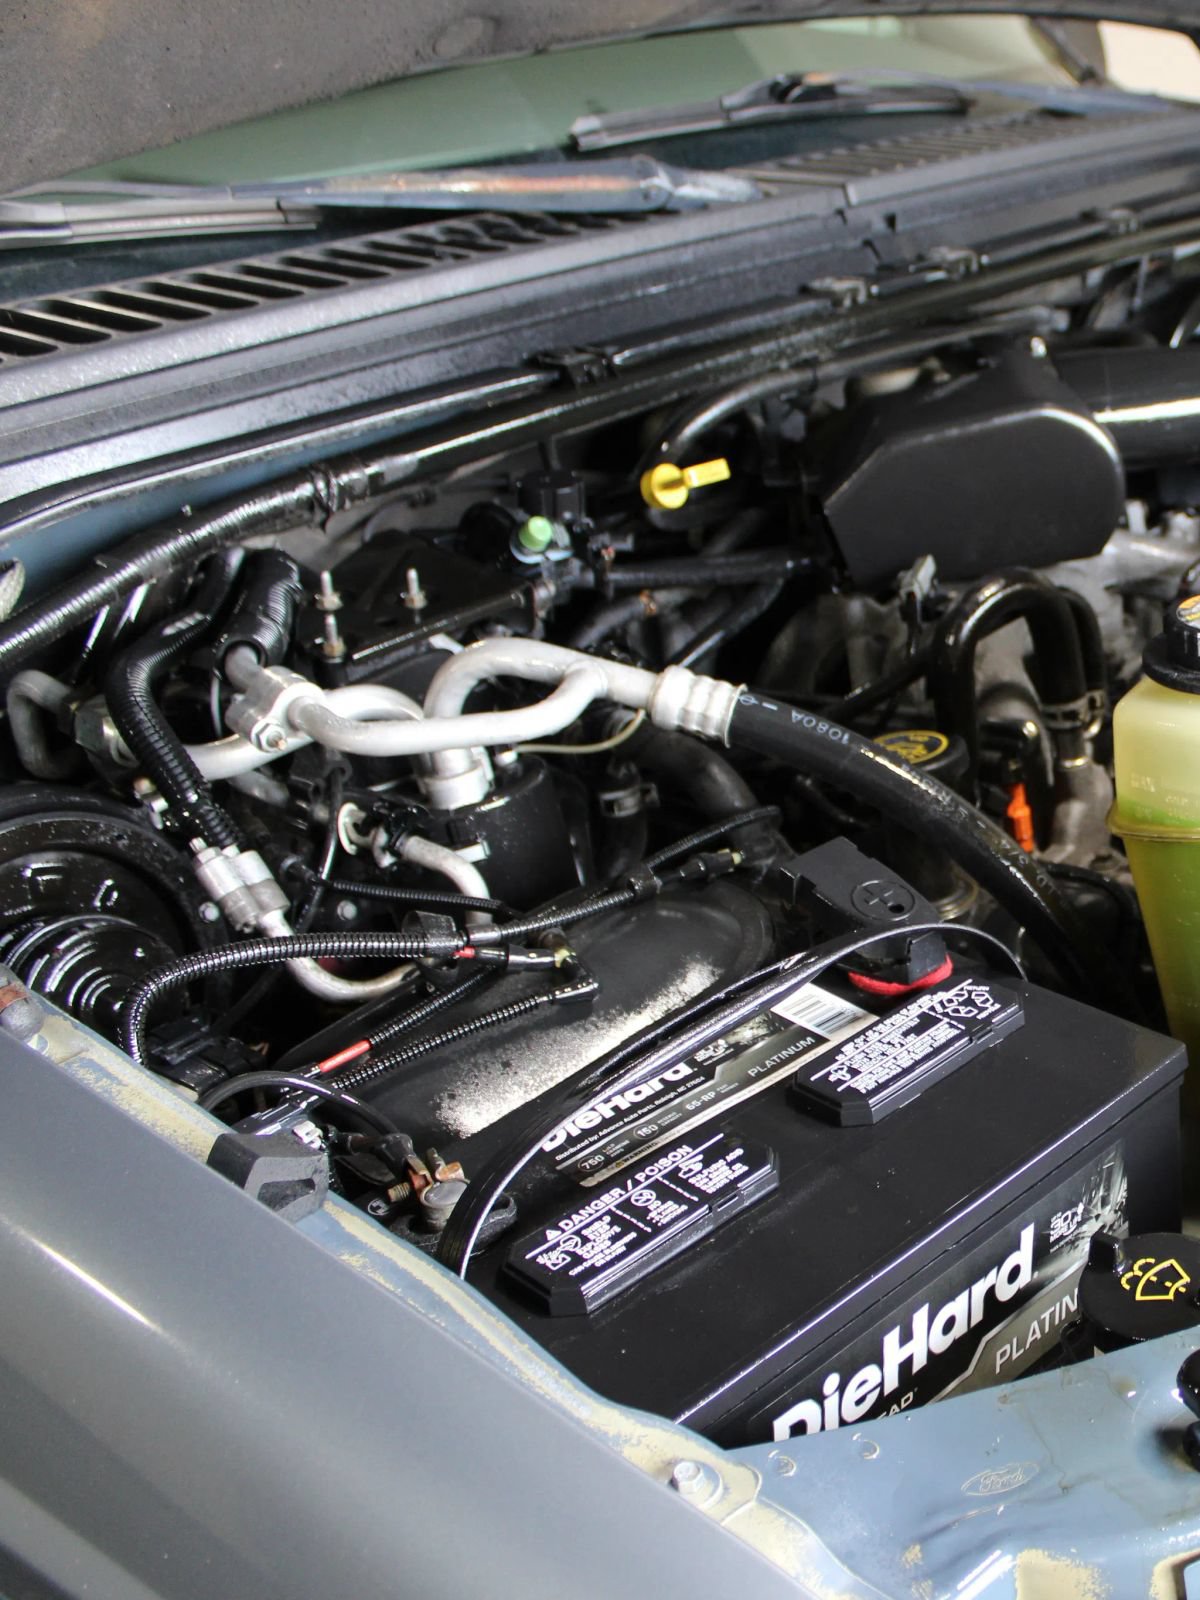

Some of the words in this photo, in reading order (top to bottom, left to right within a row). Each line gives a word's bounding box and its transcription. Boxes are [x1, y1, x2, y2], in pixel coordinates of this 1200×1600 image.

[791, 709, 849, 745] 1080A
[579, 1153, 607, 1169] 750
[634, 1122, 660, 1137] 150
[682, 1090, 719, 1111] 65-RP
[744, 1035, 818, 1077] PLATINUM
[553, 1139, 590, 1161] Distributed
[596, 1119, 625, 1136] Advance
[621, 1112, 639, 1123] Auto
[722, 1146, 746, 1162] ACID
[559, 1186, 626, 1231] DANGER
[634, 1145, 693, 1183] POISON
[645, 1199, 663, 1210] NO
[773, 1222, 1034, 1442] DieHard
[995, 1288, 1079, 1375] PLATIN
